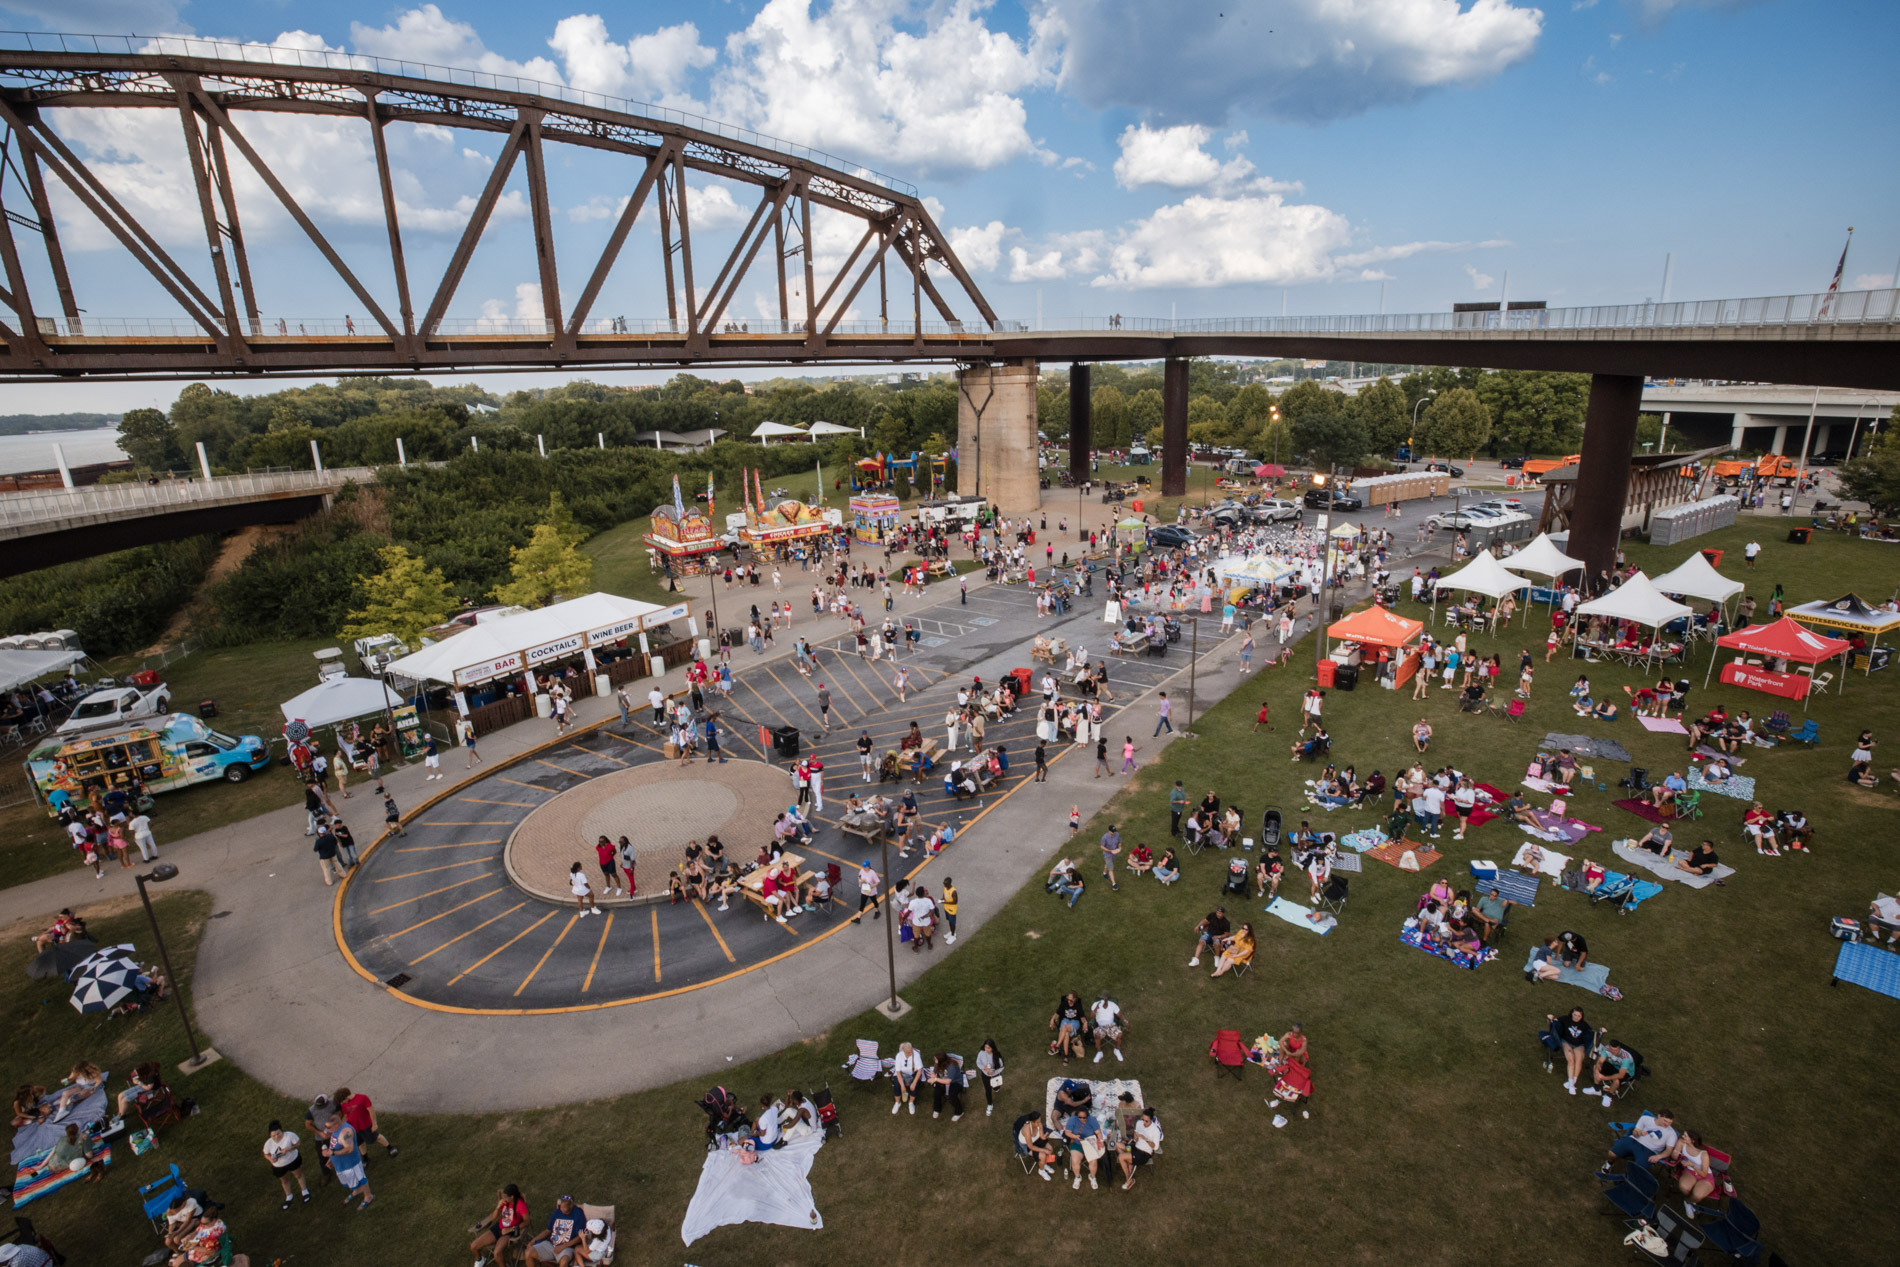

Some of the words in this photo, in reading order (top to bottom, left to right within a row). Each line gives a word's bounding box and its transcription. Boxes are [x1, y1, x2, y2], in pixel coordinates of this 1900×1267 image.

[1786, 613, 1877, 632] ABSOLUTESERVICES.NET
[592, 628, 613, 640] WINE
[614, 622, 634, 634] BEER
[1345, 632, 1365, 640] Waffle
[531, 639, 577, 659] COCKTAILS
[1747, 644, 1777, 655] Waterfront
[494, 658, 516, 671] BAR
[1747, 679, 1762, 688] Park
[1748, 674, 1784, 688] Waterfront
